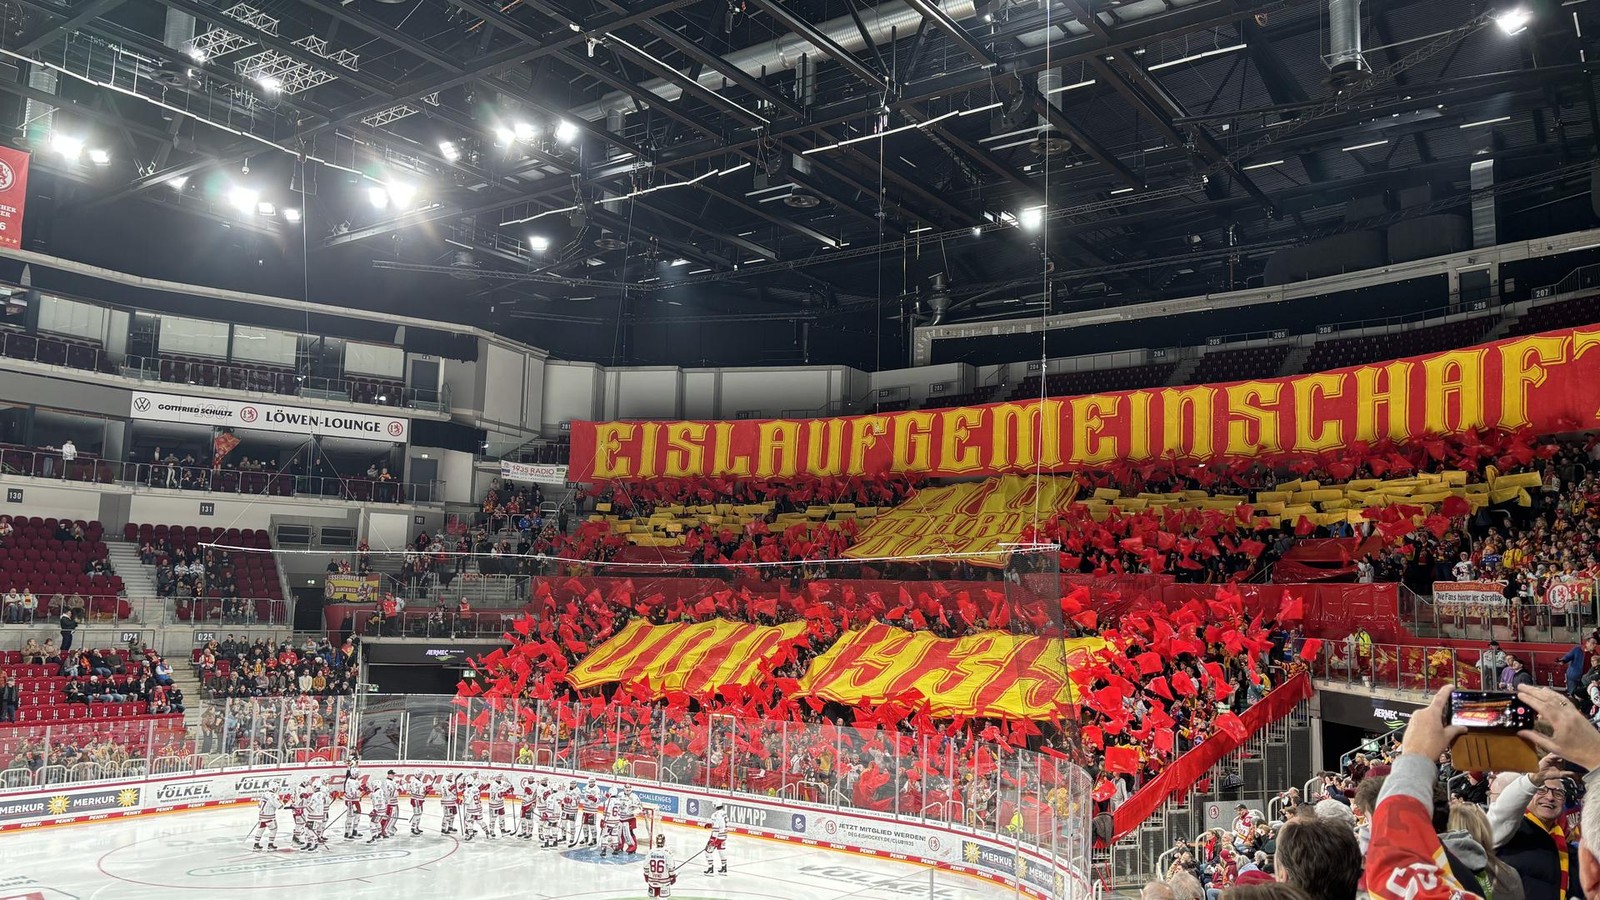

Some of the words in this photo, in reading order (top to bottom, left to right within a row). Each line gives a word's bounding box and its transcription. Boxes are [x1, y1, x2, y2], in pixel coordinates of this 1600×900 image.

[1535, 288, 1549, 298] 207
[157, 403, 200, 414] GOTTFRIED
[200, 407, 233, 417] SCHULTZ
[265, 408, 381, 433] LÖWEN-LOUNGE
[9, 491, 22, 500] 130
[201, 505, 213, 513] 131
[1445, 593, 1457, 601] Fans
[198, 632, 213, 641] 025
[1373, 708, 1398, 720] AERMEC
[156, 784, 212, 799] VÖLKEL
[72, 795, 116, 807] MERKUR
[639, 793, 672, 803] CHALLENGES
[0, 802, 44, 815] MERKUR
[838, 823, 858, 831] JETZT
[859, 826, 893, 836] MITGLIED
[893, 831, 927, 842] WERDEN!
[981, 851, 1013, 867] MERKUR
[649, 859, 665, 874] 86
